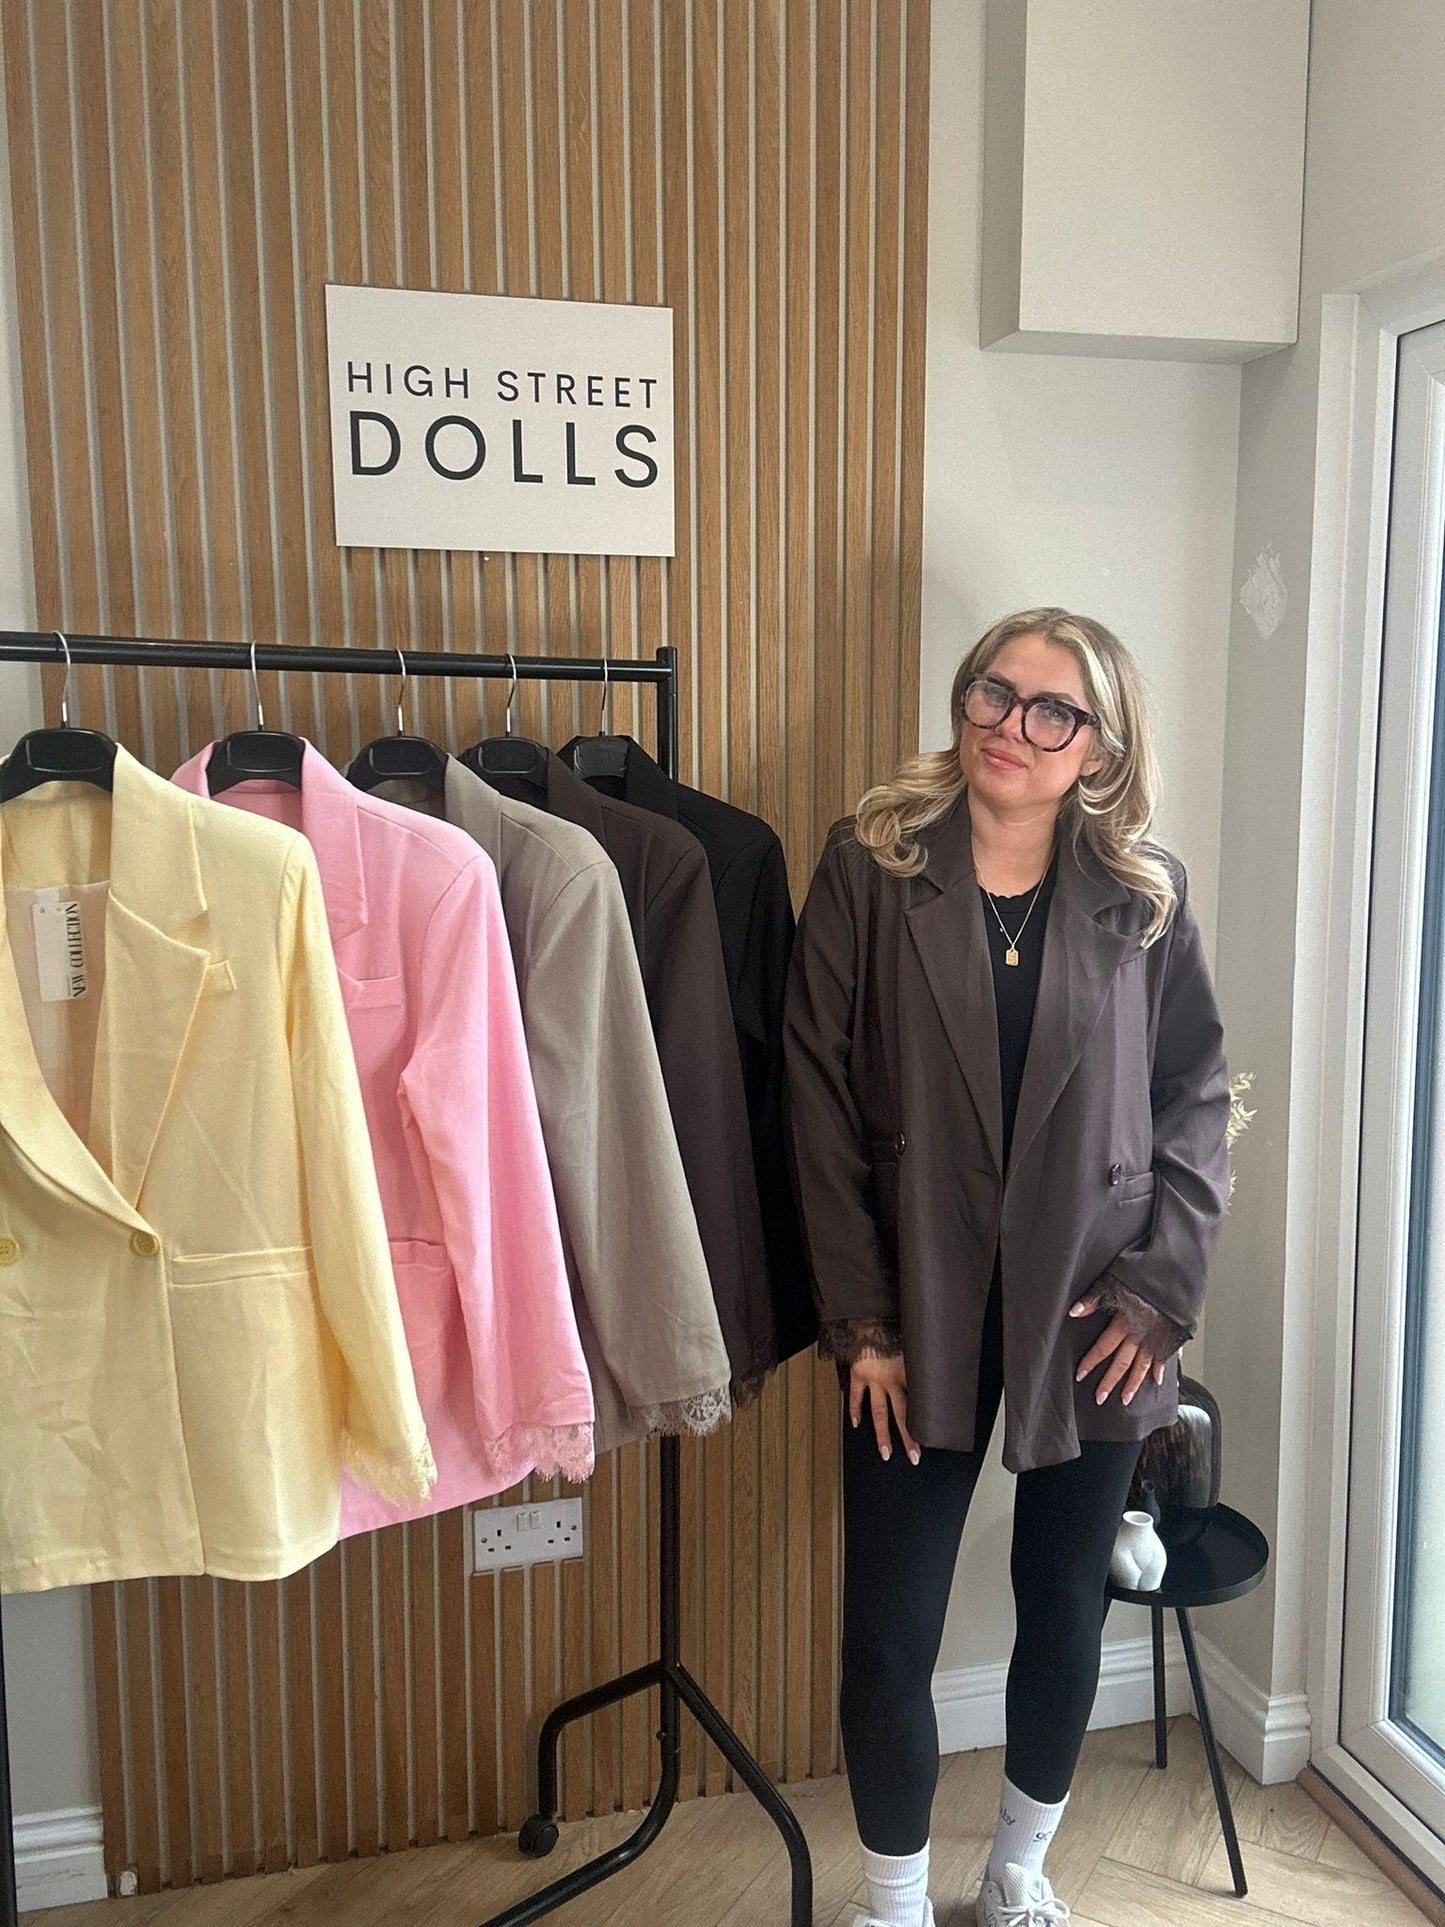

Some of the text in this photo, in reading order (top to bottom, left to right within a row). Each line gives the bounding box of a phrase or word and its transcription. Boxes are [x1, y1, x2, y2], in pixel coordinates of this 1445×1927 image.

[347, 361, 657, 409] HIGH STREET
[349, 410, 658, 488] DOLLS
[65, 903, 86, 997] NEW COLLECTION
